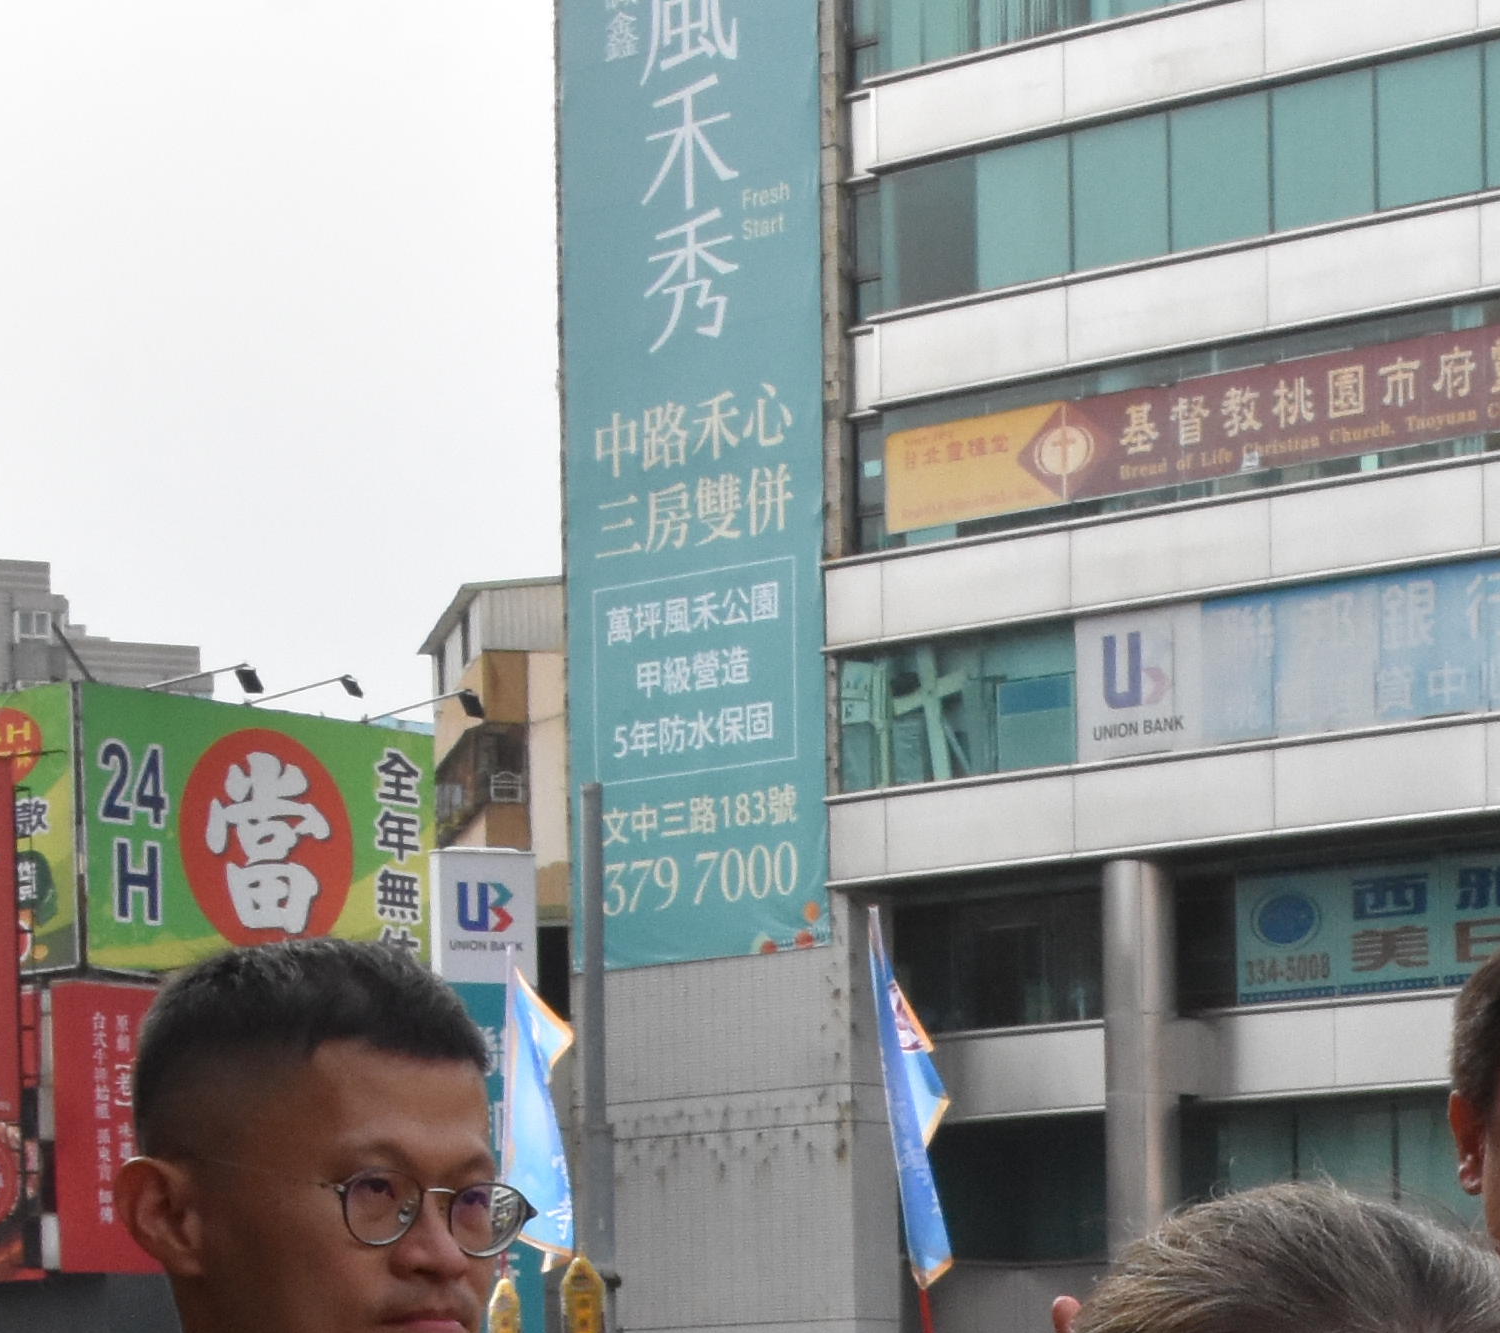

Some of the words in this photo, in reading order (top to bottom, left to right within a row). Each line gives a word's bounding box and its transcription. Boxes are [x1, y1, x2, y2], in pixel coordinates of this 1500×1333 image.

[742, 181, 791, 211] Fresh
[742, 213, 786, 241] Start
[594, 383, 794, 479] 中路禾心
[594, 463, 795, 560] 三房雙併
[606, 581, 780, 646] 萬坪風禾公園
[636, 645, 751, 699] 甲級營造
[612, 702, 774, 761] 5年防水保固
[1094, 721, 1139, 743] UNION
[1143, 714, 1185, 737] BANK
[100, 739, 168, 827] 24
[602, 782, 798, 848] 文中三路183號
[205, 750, 332, 934] 當
[112, 837, 162, 924] H
[602, 869, 681, 917] 379
[695, 840, 799, 907] 7000
[449, 940, 488, 952] UNION
